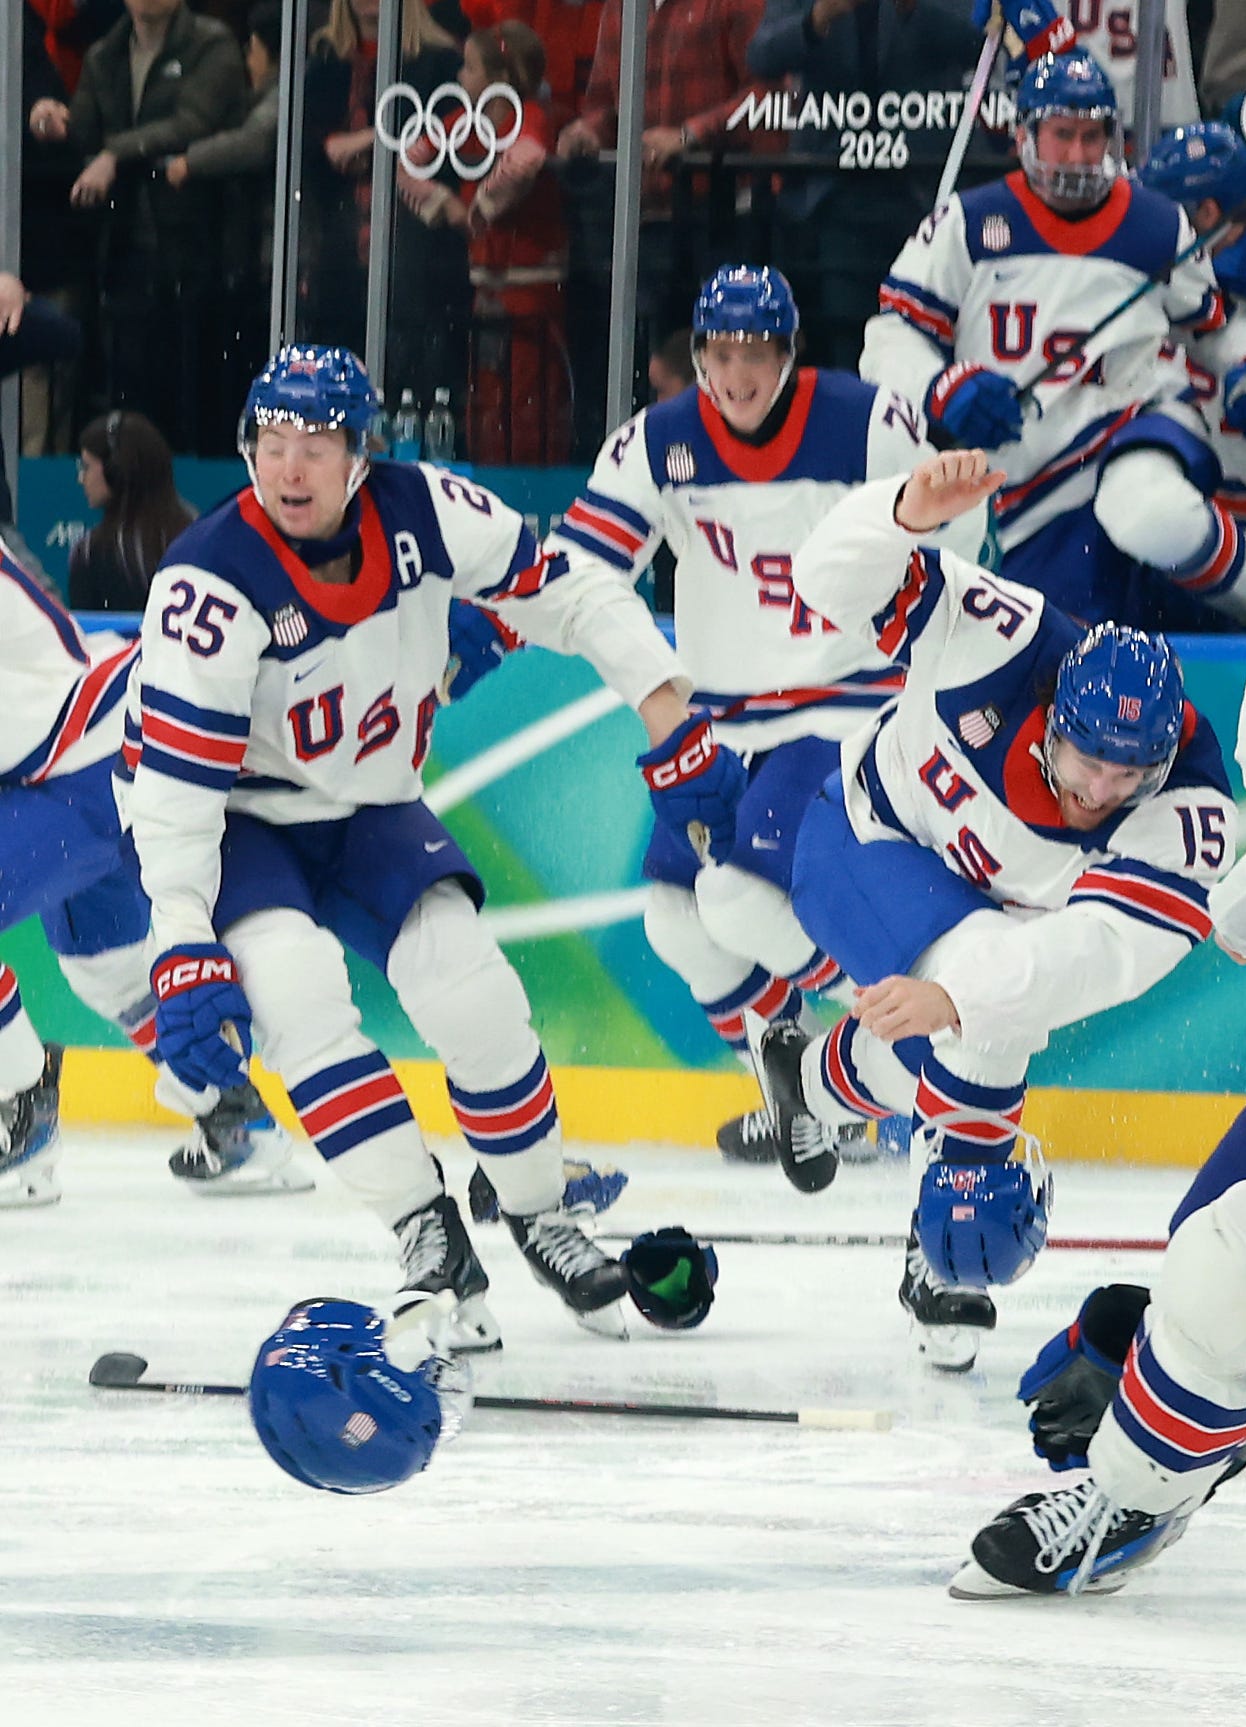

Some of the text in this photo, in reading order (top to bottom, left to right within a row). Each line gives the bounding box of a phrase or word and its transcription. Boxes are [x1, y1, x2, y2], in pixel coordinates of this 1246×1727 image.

[726, 90, 872, 131] MILANO
[839, 130, 909, 170] 2026
[394, 530, 423, 586] A
[161, 578, 239, 659] 25
[962, 575, 1034, 641] 15
[1117, 695, 1142, 720] 15
[1173, 805, 1226, 870] 15
[157, 958, 232, 998] CCM
